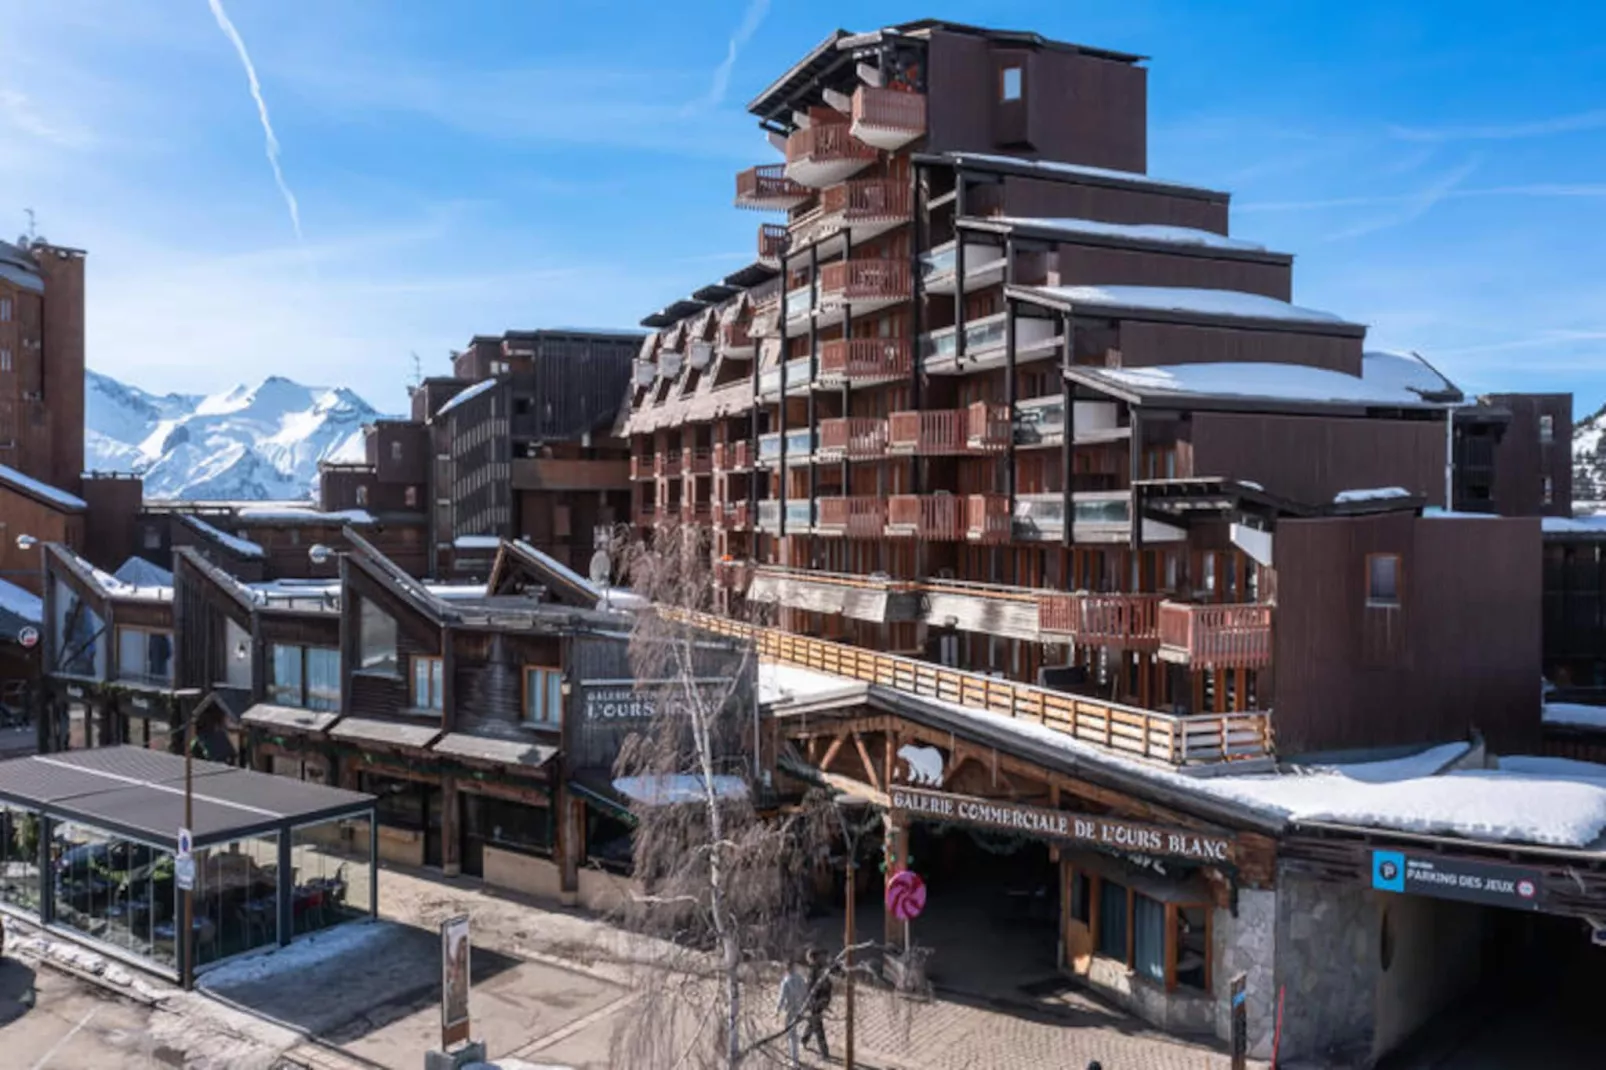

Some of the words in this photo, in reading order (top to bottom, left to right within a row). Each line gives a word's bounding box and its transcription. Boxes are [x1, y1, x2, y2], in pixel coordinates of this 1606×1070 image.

[587, 702, 655, 718] L'OURS
[893, 792, 952, 815] GALERIE
[958, 802, 1068, 834] COMMERCIALE
[1074, 820, 1096, 839] DE
[1101, 825, 1162, 848] L'OURS
[1168, 835, 1228, 860] BLANC
[1407, 868, 1457, 885] PARKING
[1458, 876, 1482, 889] DES
[1484, 878, 1514, 893] JEUX
